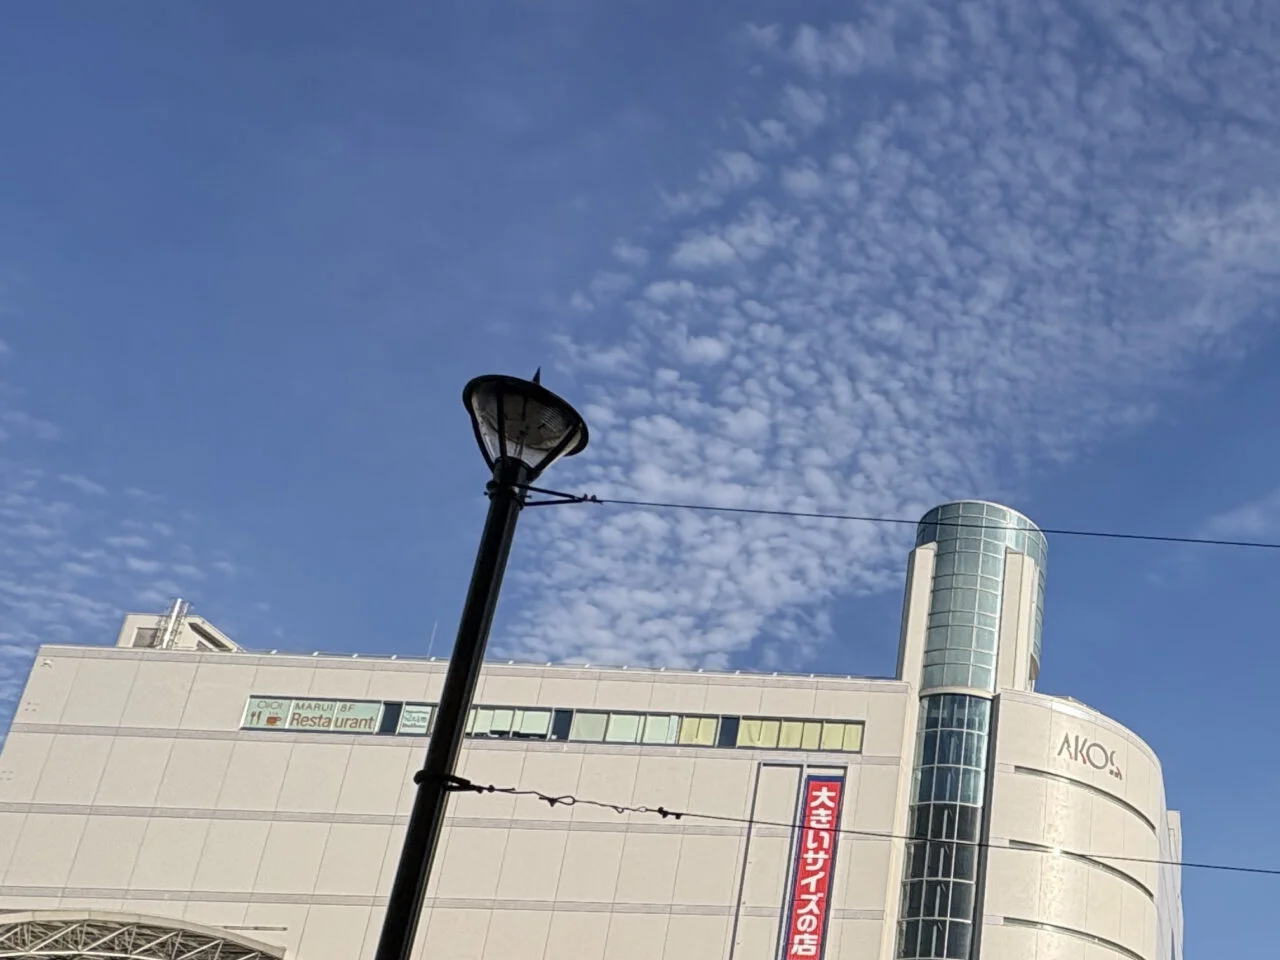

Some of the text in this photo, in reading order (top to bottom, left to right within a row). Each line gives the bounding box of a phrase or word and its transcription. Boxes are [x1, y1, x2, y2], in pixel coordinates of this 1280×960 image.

[289, 712, 376, 730] Restaurant
[295, 702, 334, 712] MARUI
[1057, 732, 1123, 781] AKOS
[790, 785, 837, 957] 大きいサイズの店
